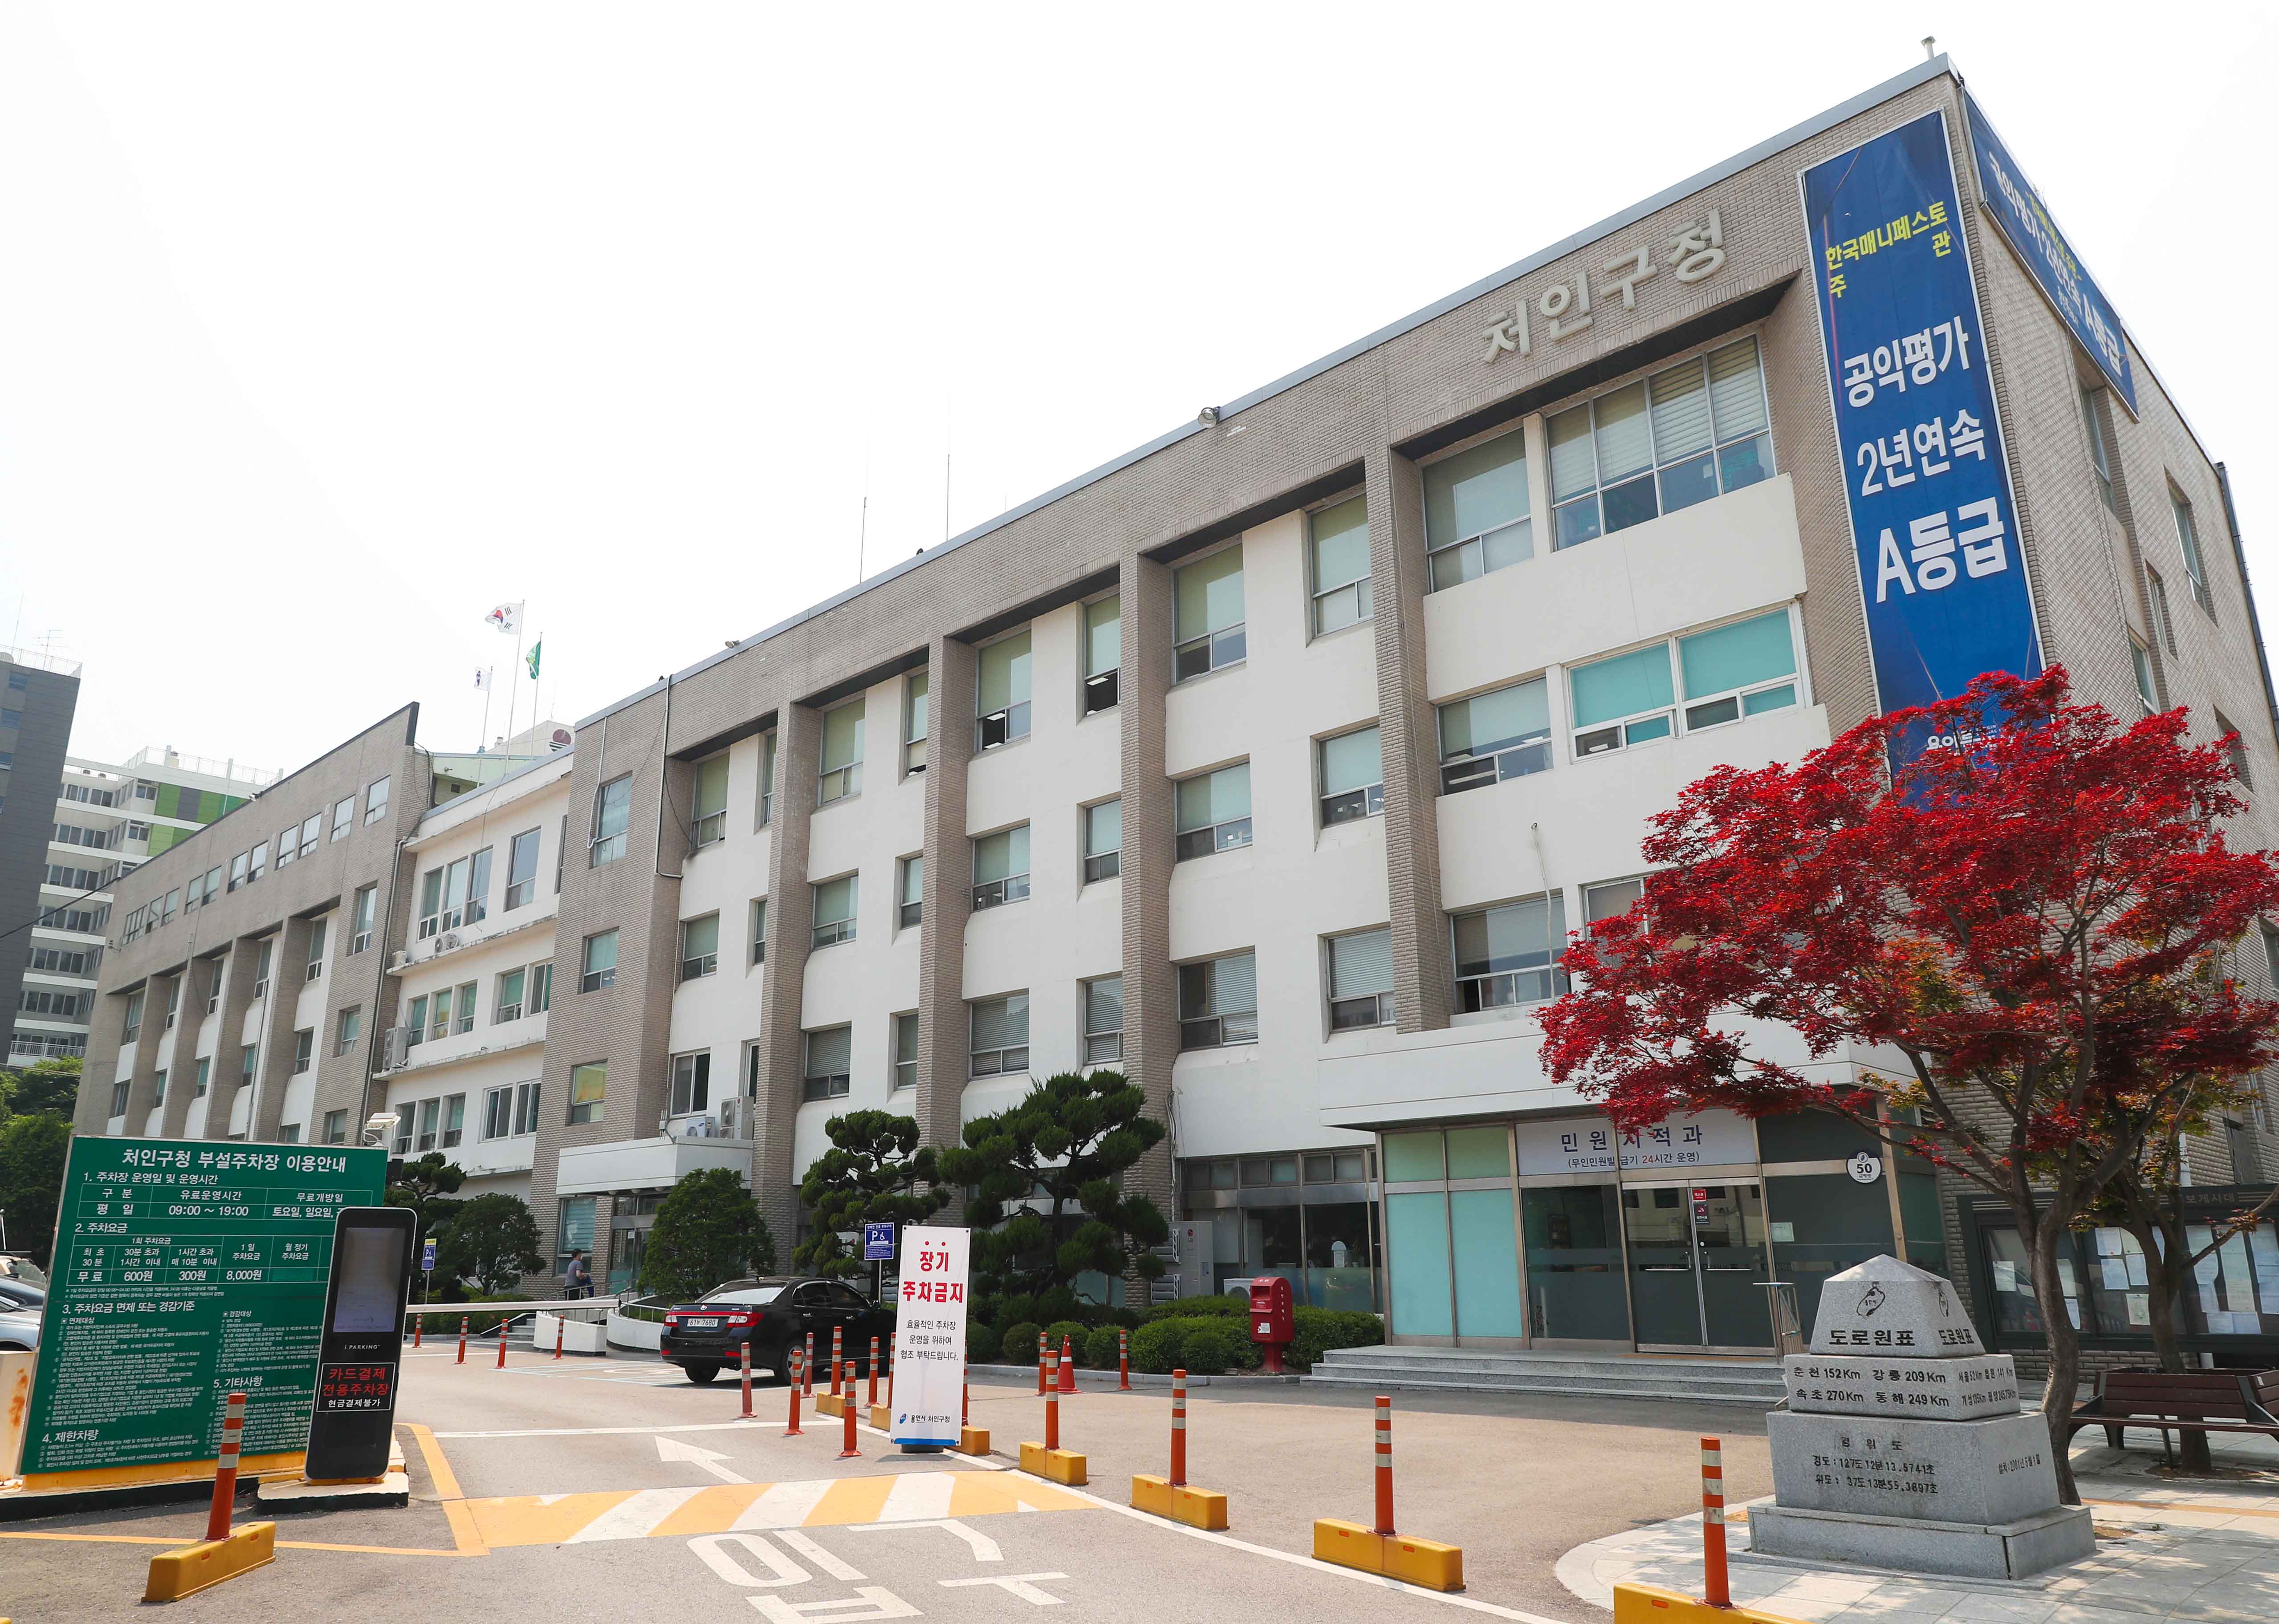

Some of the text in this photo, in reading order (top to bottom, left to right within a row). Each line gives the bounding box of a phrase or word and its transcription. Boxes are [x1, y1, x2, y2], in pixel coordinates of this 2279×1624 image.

[1825, 201, 1948, 270] 한국매니페스토
[1830, 232, 1951, 298] 주 관
[1989, 151, 2043, 253] 공익평가
[2043, 236, 2083, 316] 2년연속
[2083, 292, 2123, 377] A등급
[1482, 207, 1726, 363] 처인구청
[1844, 316, 1970, 407] 공익평가
[1857, 409, 1986, 497] 2년연속
[1876, 496, 2007, 603] A등급
[122, 1149, 346, 1173] 처인구청 부설주차장 이용안내
[1642, 1153, 1673, 1165] 24시간
[1677, 1151, 1700, 1162] 운영)
[1857, 1163, 1872, 1173] 50
[84, 1172, 218, 1185] 1. 주차장 운영일 및 운영시간
[180, 1190, 242, 1201] 유료운영시간
[296, 1193, 343, 1203] 무료개방일
[168, 1206, 200, 1215] 09:00
[219, 1206, 249, 1216] 19:00
[272, 1207, 301, 1218] 토요일,
[305, 1207, 334, 1218] 일요일,
[75, 1223, 128, 1233] 2. 주차요금
[872, 1231, 878, 1241] P
[125, 1248, 142, 1256] 30분
[144, 1248, 159, 1256] 초과
[178, 1248, 197, 1256] 1시간
[199, 1248, 214, 1256] 초과
[232, 1252, 260, 1261] 주차요금
[282, 1252, 309, 1260] 주차요금
[121, 1259, 140, 1267] 1시간
[146, 1258, 161, 1267] 이내
[182, 1258, 198, 1266] 10분
[203, 1258, 217, 1266] 이내
[920, 1251, 949, 1272] 장기
[77, 1270, 262, 1282] 무료 600원 300원 8,000원
[903, 1281, 963, 1303] 주차금지
[62, 1301, 195, 1314] 3. 주차요금 면제 또는 경감기준
[907, 1320, 956, 1330] 효율적인 주차장
[909, 1335, 952, 1345] 운영을 위하여
[1829, 1330, 1915, 1346] 도로원표
[1938, 1328, 1975, 1345] 도로원표
[901, 1350, 958, 1360] 협조 부탁드립니다.
[330, 1368, 386, 1381] 카드결제
[213, 1376, 263, 1388] 5. 기타사항
[323, 1384, 390, 1397] 전용주차장
[328, 1398, 381, 1408] 현금결제불가
[911, 1415, 926, 1423] 용인시
[42, 1429, 99, 1443] 4. 제한차량
[1839, 1458, 1864, 1469] 127도
[1866, 1460, 1883, 1470] 12분
[1848, 1477, 1866, 1488] 37도
